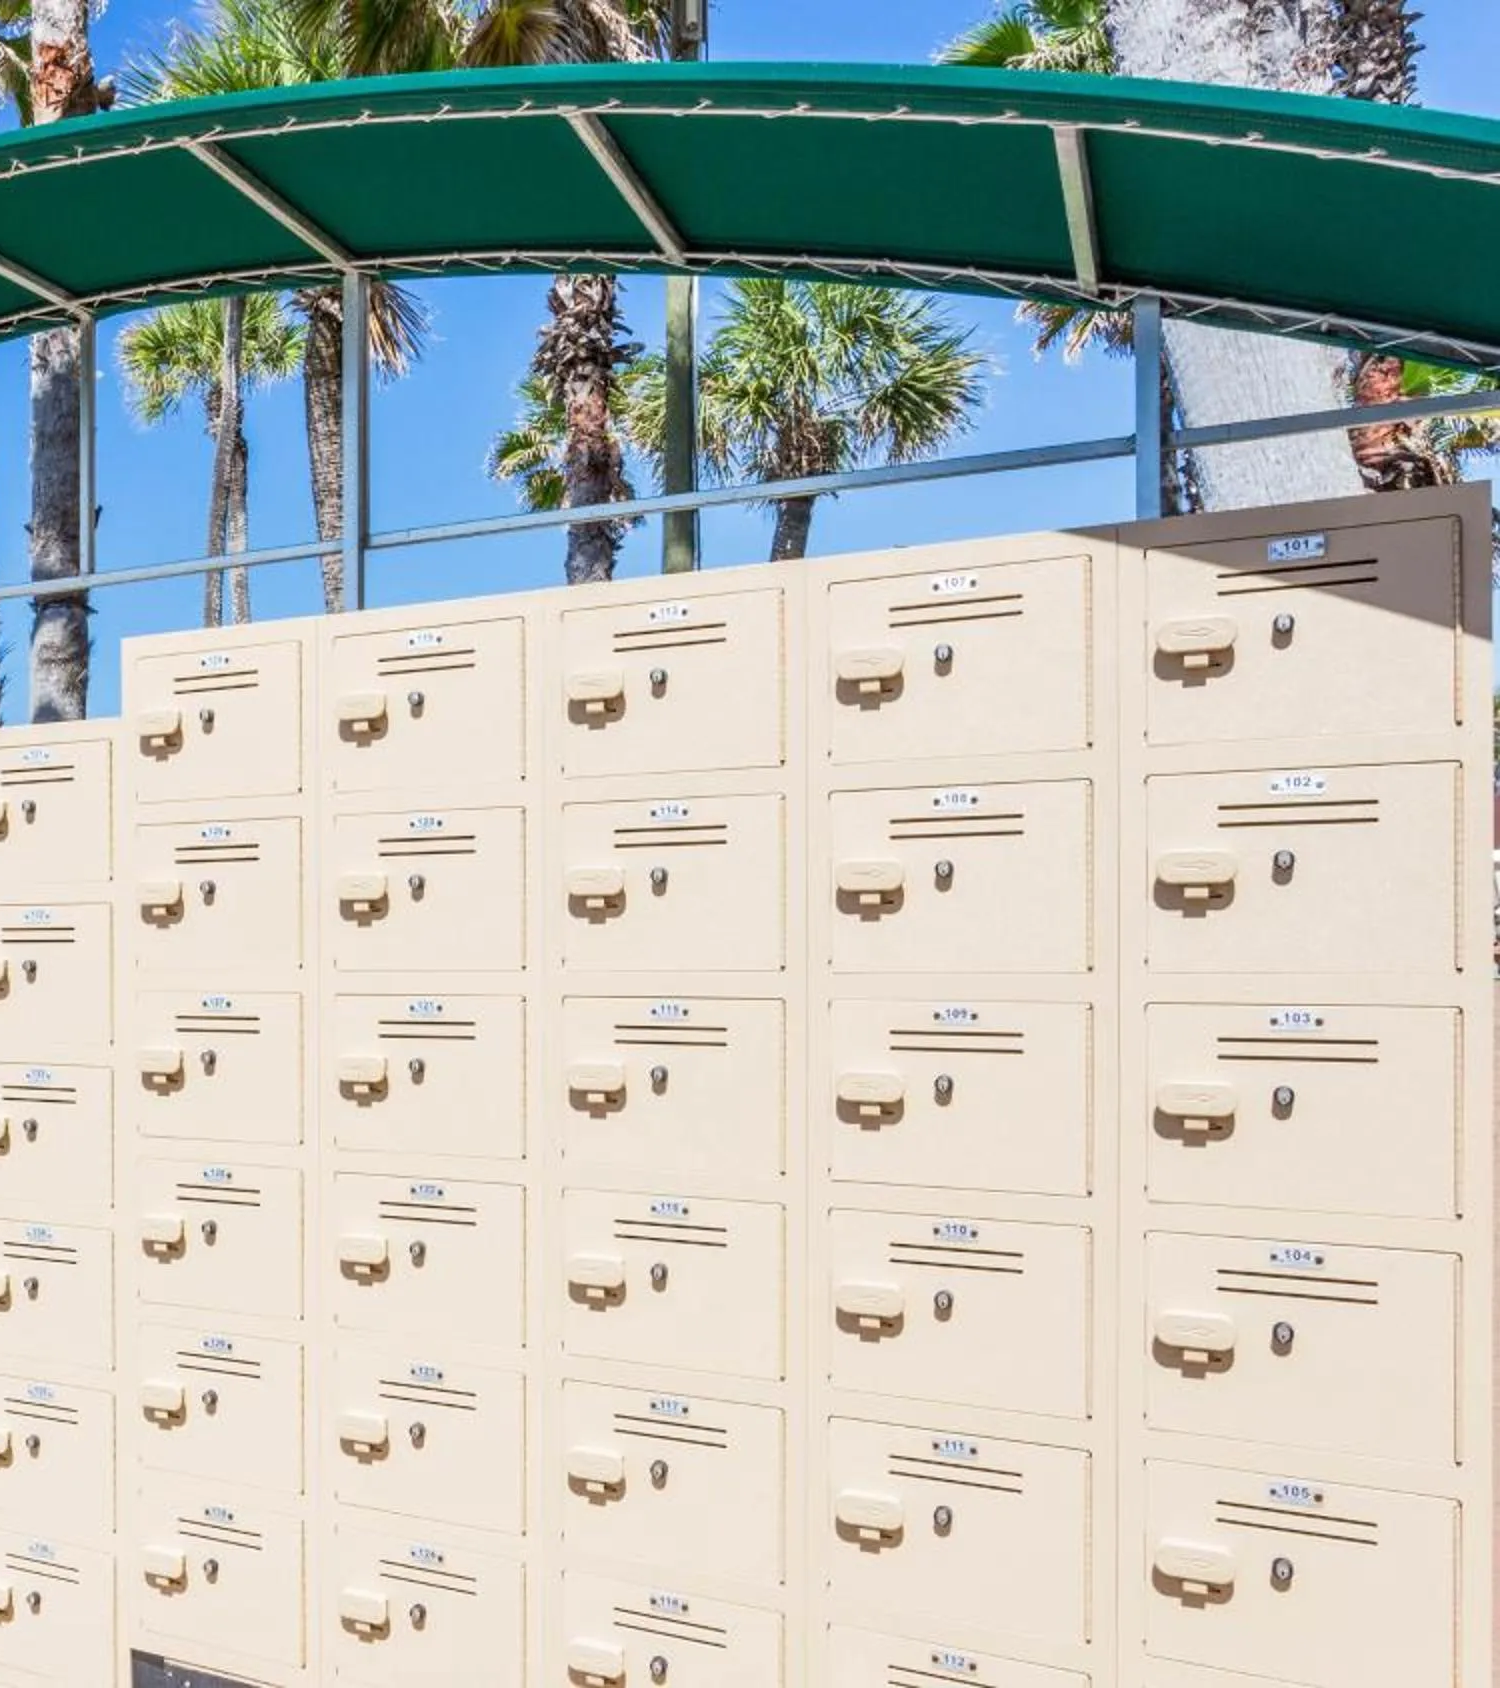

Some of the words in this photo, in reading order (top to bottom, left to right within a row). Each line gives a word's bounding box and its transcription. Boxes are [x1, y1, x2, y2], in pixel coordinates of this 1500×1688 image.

[1283, 539, 1309, 552] 101
[944, 576, 966, 588] 107
[1285, 776, 1312, 787] 102
[945, 1009, 968, 1019] 109
[1284, 1012, 1311, 1023] 103
[945, 1221, 967, 1233] 110
[1284, 1249, 1311, 1261] 104
[944, 1440, 965, 1451] 111
[1283, 1485, 1310, 1498] 105
[944, 1654, 965, 1667] 112
